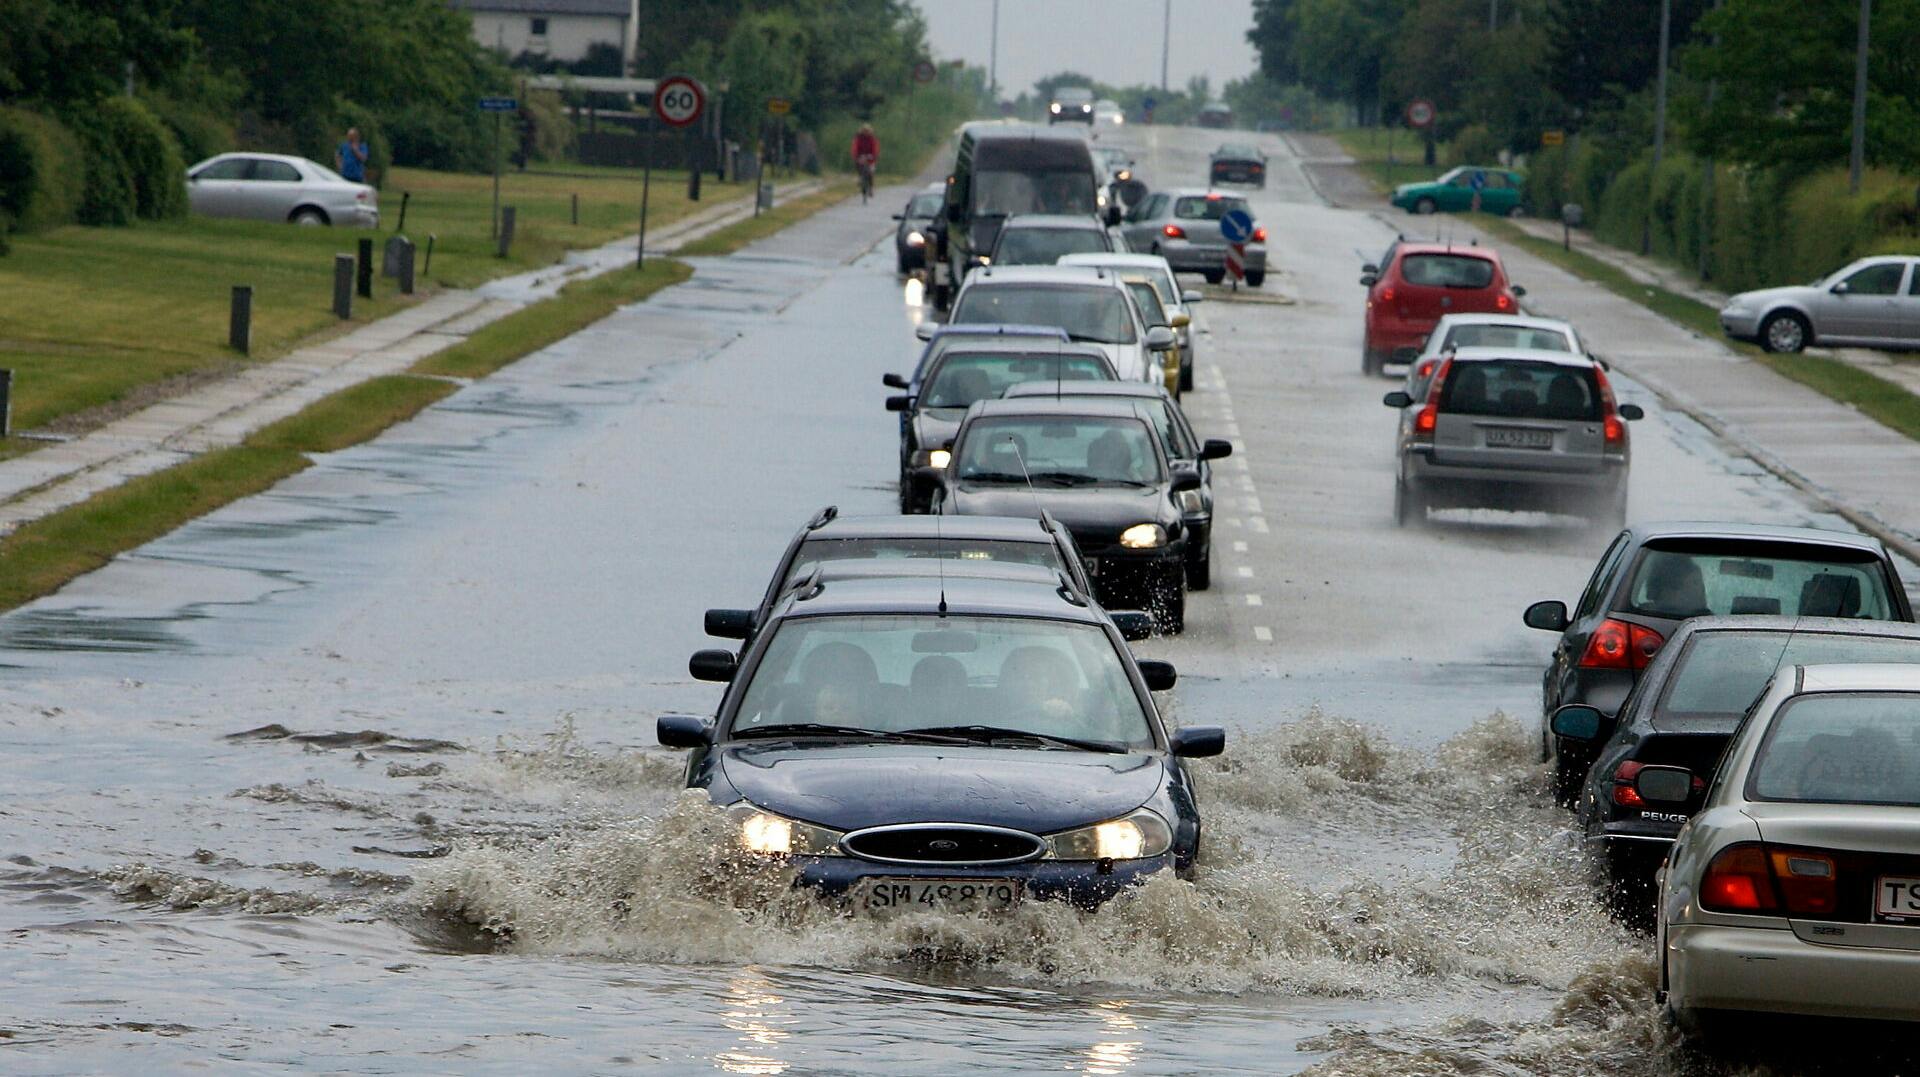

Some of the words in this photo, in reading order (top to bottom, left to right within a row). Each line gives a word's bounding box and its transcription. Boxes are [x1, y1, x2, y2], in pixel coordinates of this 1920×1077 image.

[664, 91, 694, 110] 60
[1641, 811, 1689, 823] PEUGE
[872, 884, 911, 907] SM
[1885, 882, 1920, 910] TS
